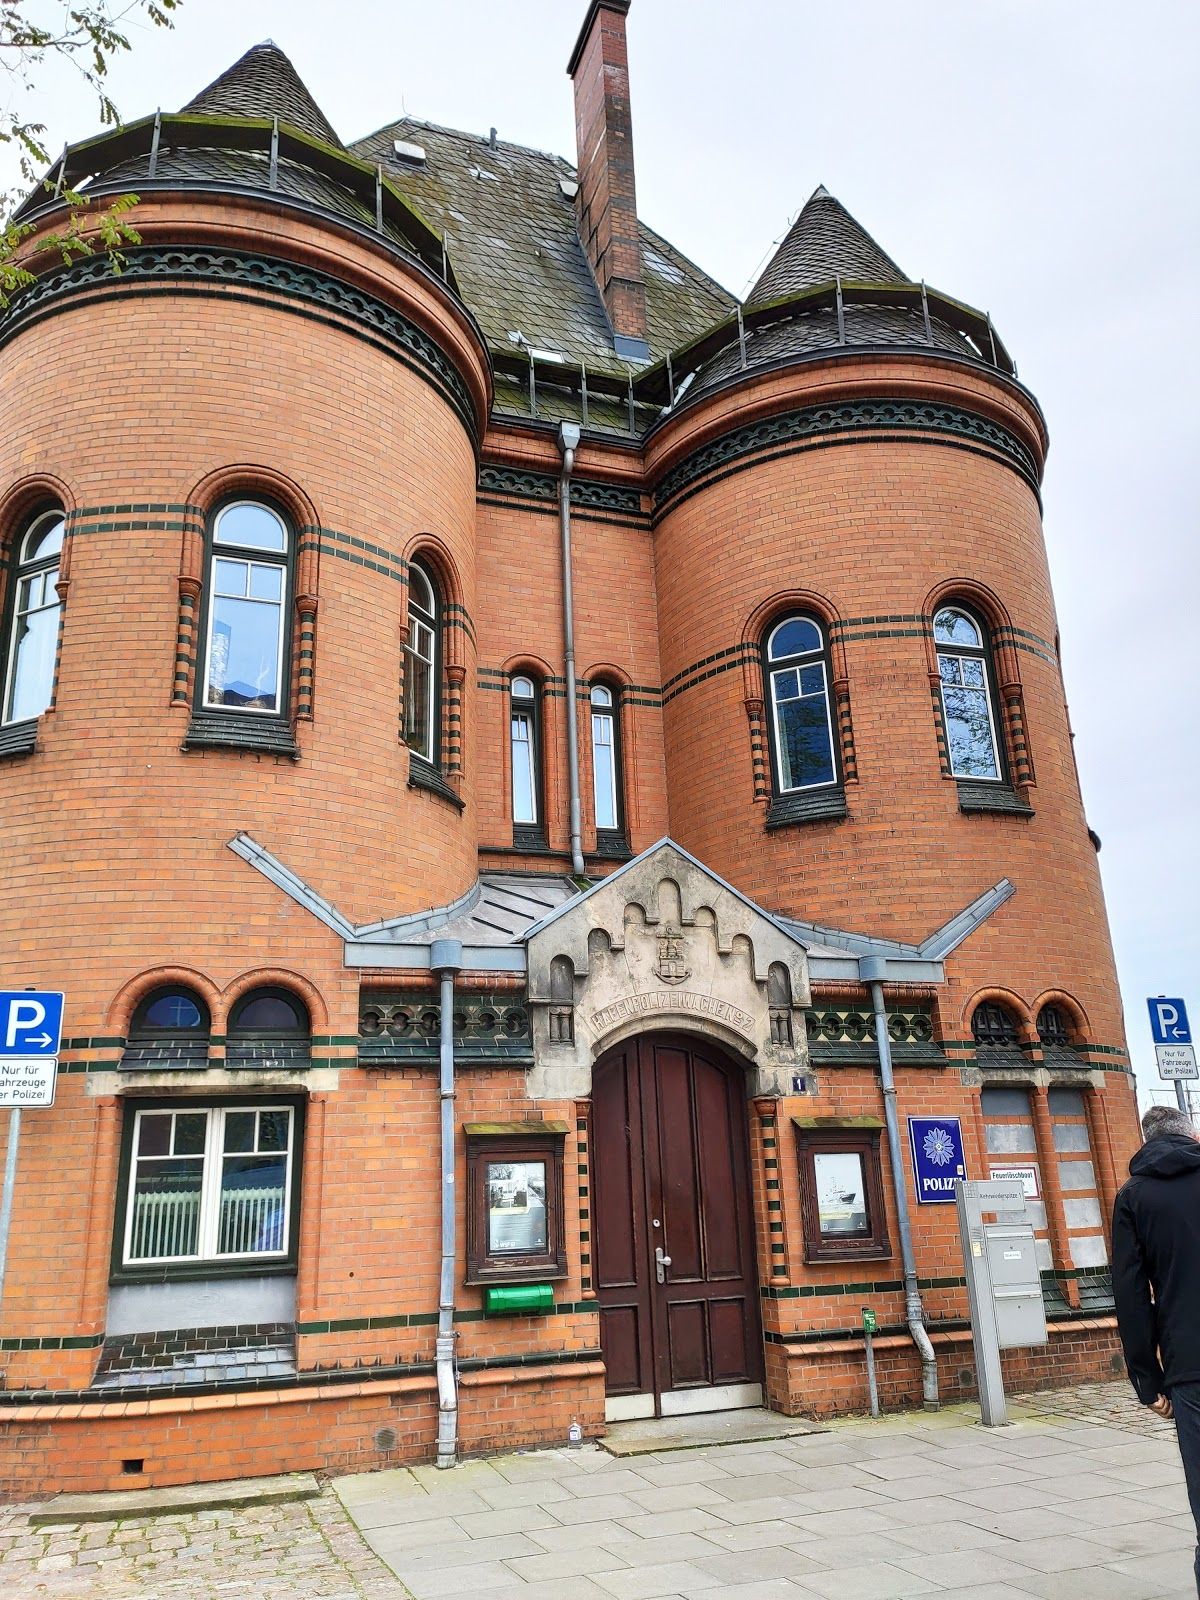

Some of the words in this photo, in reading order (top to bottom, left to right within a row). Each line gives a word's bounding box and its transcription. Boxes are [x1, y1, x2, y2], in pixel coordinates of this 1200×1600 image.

[592, 991, 726, 1029] HAFENPOLIZEIWACHE
[741, 1017, 756, 1033] 2
[5, 999, 46, 1047] P
[1156, 1003, 1179, 1038] P
[1162, 1058, 1192, 1066] Fahrzeuge
[1, 1065, 21, 1075] Nur
[24, 1065, 40, 1075] für
[796, 1077, 802, 1090] 1
[12, 1089, 46, 1099] Polizei
[923, 1177, 962, 1190] POLIZ
